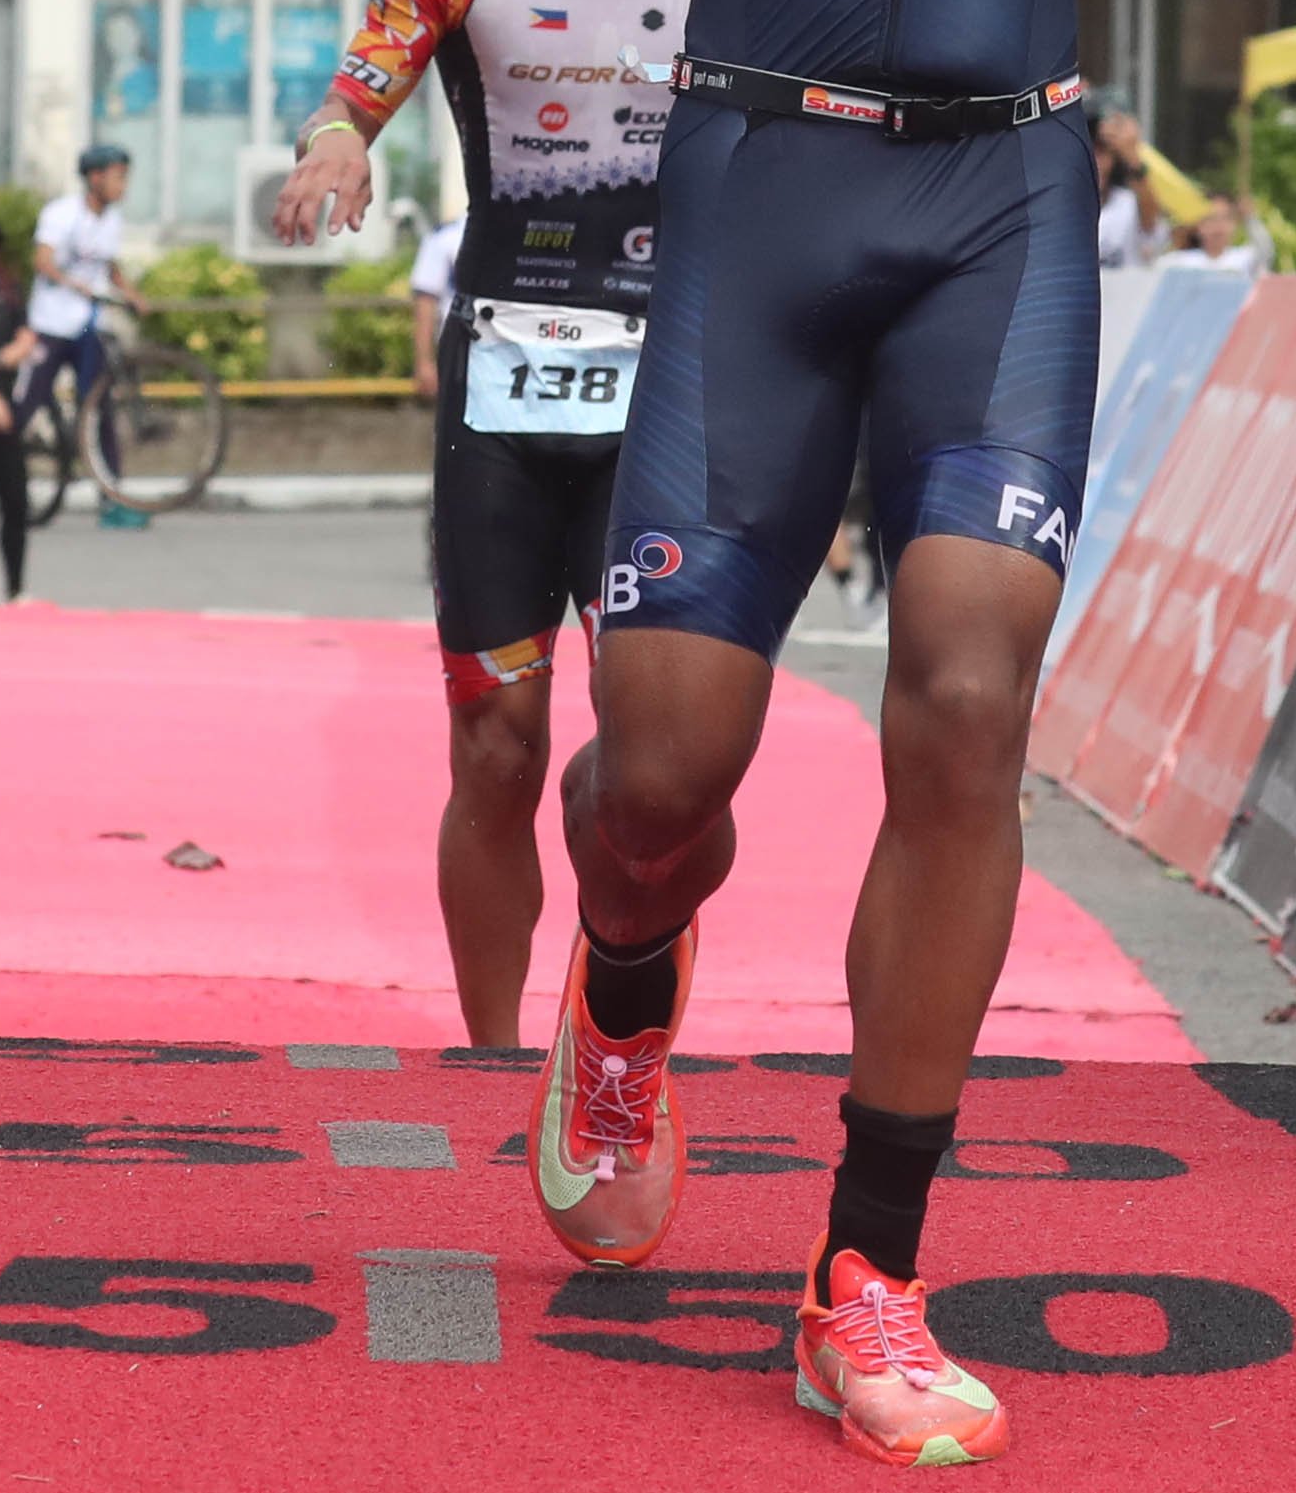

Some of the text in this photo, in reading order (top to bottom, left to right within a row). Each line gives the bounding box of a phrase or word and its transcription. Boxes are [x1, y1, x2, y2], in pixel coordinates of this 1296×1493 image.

[507, 63, 553, 82] GO
[555, 65, 617, 84] FOR
[511, 134, 591, 155] Magene
[509, 363, 619, 404] 138
[997, 483, 1074, 572] FA
